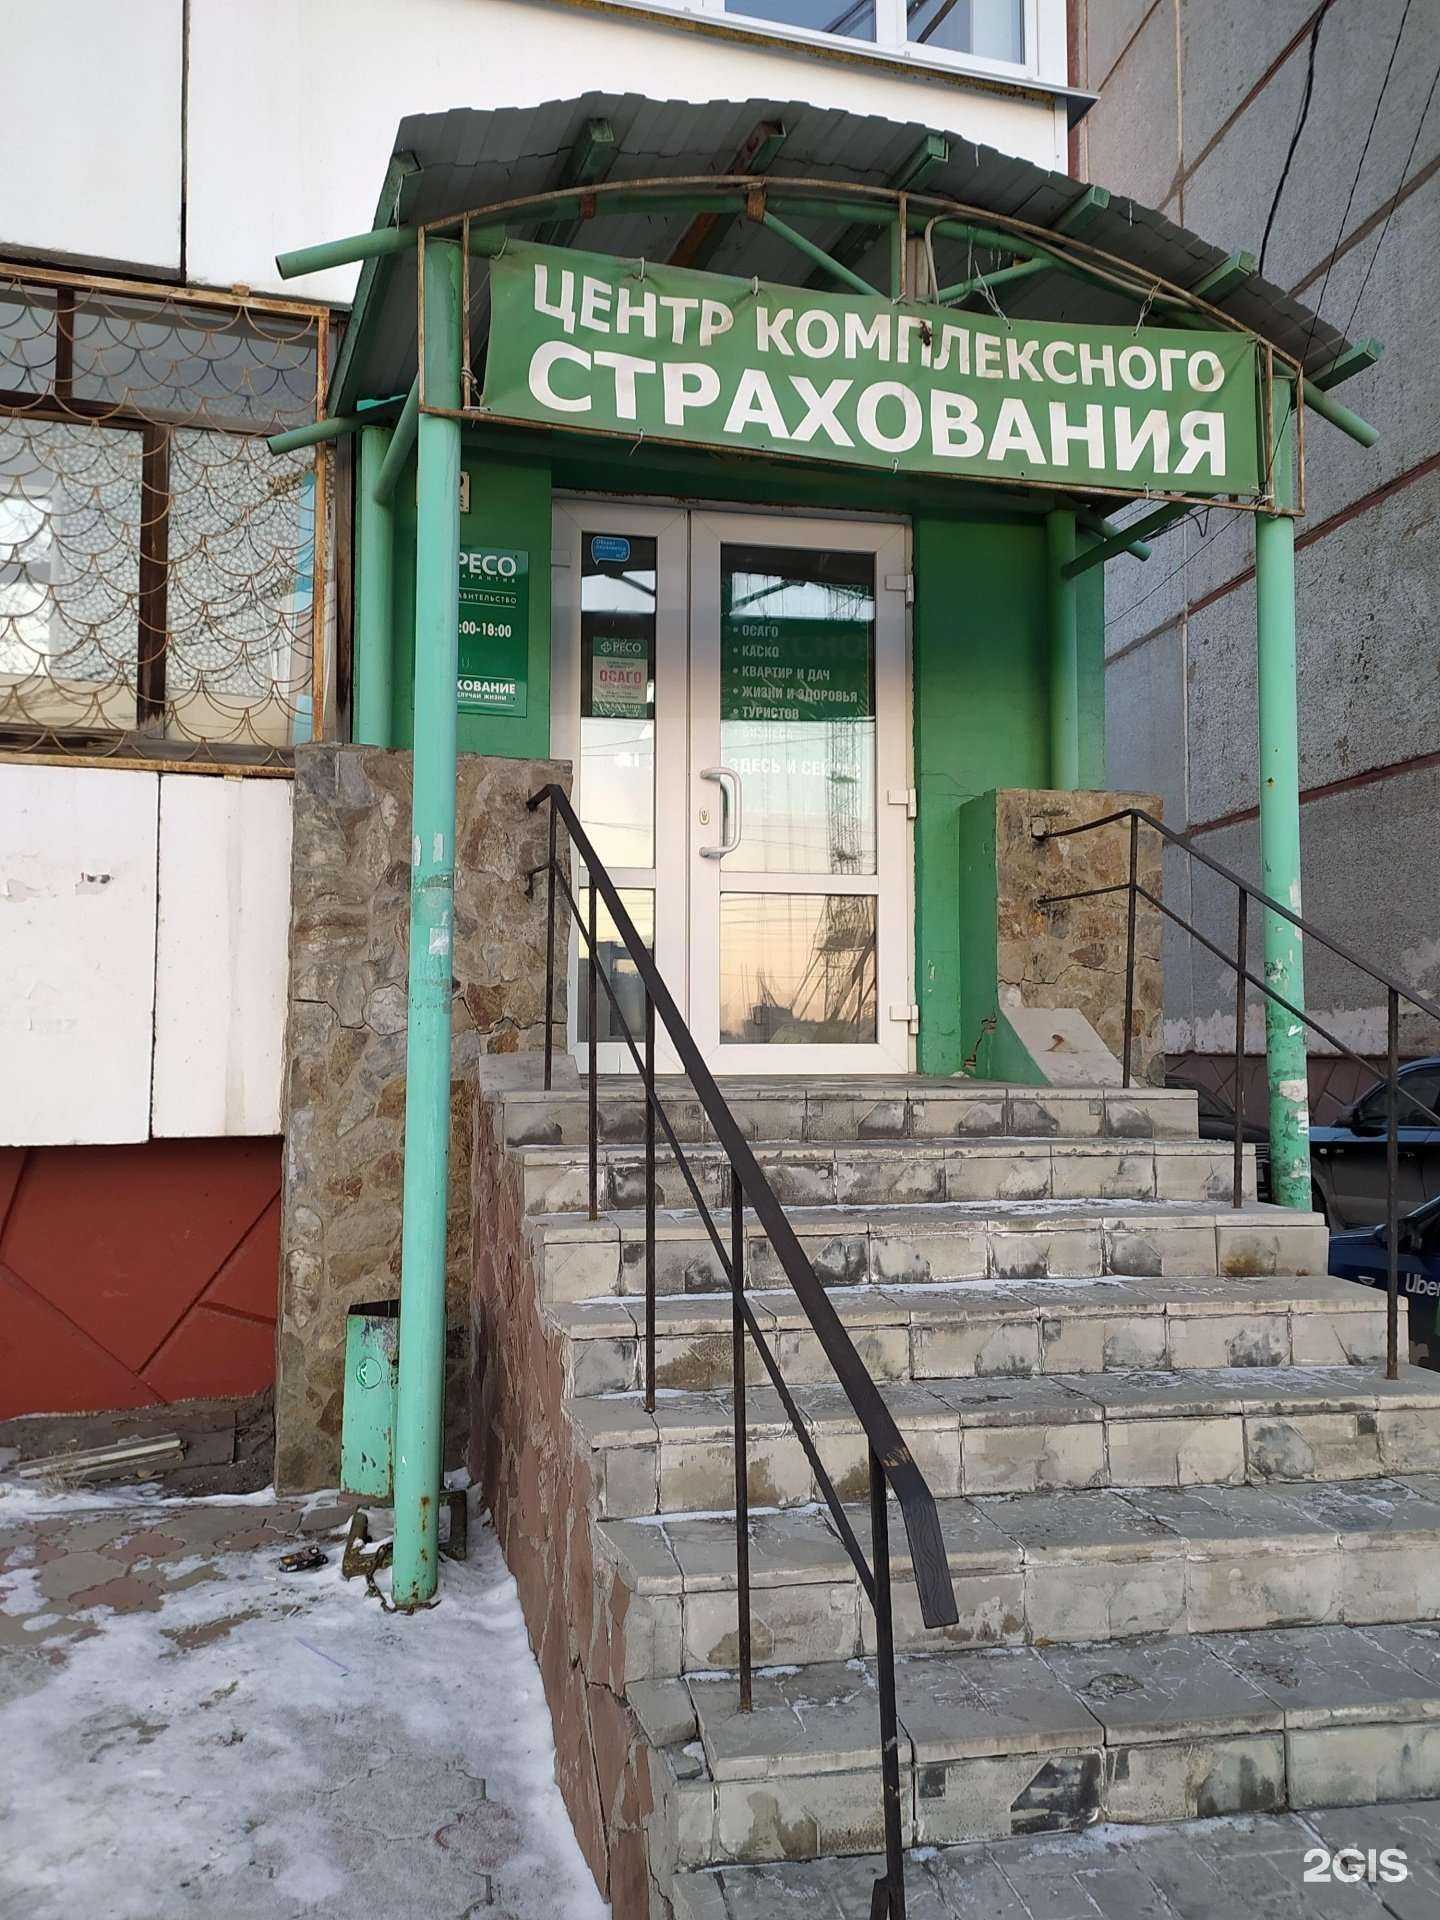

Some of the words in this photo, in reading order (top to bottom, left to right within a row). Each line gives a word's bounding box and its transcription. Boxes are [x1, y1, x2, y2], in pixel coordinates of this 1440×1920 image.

[534, 263, 735, 346] ЦЕНТР
[756, 306, 1226, 393] КОМПЛЕКСНОГО
[528, 340, 1227, 477] СТРАХОВАНИЯ
[461, 573, 516, 584] АРАНТИЯ
[459, 592, 517, 604] ВИТЕЛЬСТВО
[458, 620, 512, 638] :00-18:00
[742, 624, 779, 637] ОСАГО
[613, 640, 642, 654] РЕСО
[742, 645, 780, 658] КАСКО
[600, 670, 642, 684] ОСАГО
[742, 666, 793, 680] КВАРТИР
[797, 669, 805, 680] И
[807, 669, 831, 682] ДАЧ
[742, 686, 783, 700] ЖИЗНИ
[787, 689, 795, 700] И
[798, 689, 858, 704] ЗДОРОВЬЯ
[742, 705, 800, 720] ТУРИСТОВ
[729, 757, 781, 777] ЗДЕСЬ
